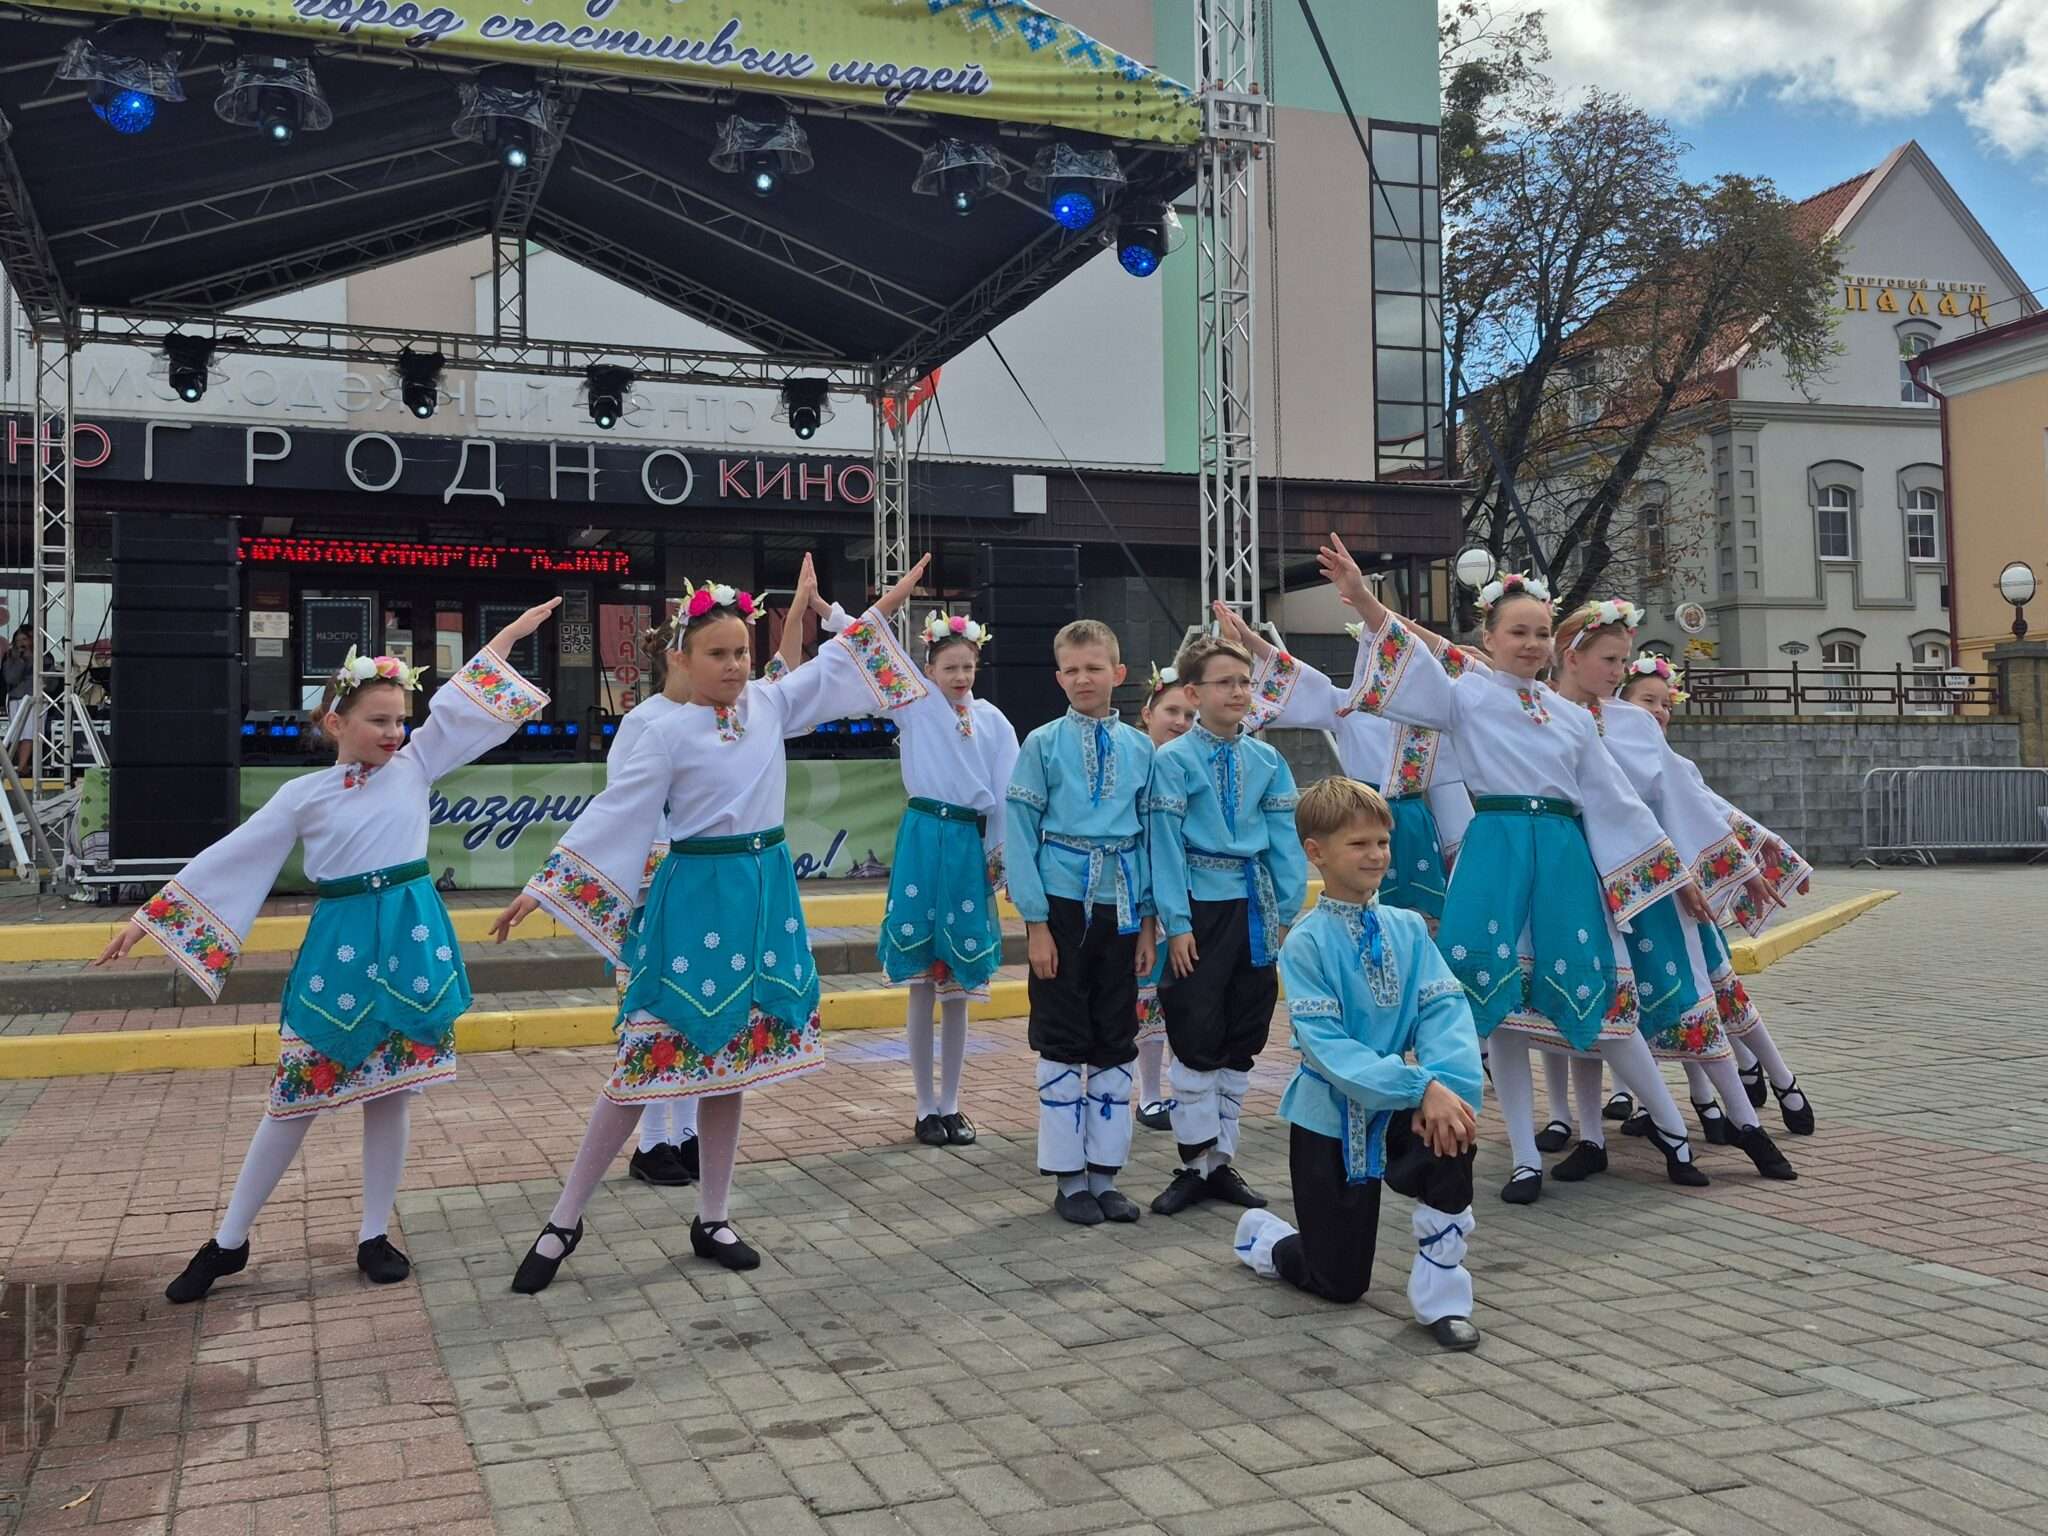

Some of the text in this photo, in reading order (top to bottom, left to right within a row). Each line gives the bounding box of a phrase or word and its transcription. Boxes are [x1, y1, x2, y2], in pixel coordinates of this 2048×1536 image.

[480, 14, 814, 77] счастливых
[829, 58, 990, 106] людей
[1845, 286, 1990, 328] ПАЛАЦ
[144, 421, 693, 506] ГРОДНО
[719, 459, 877, 504] КИНО
[429, 789, 597, 850] раздни
